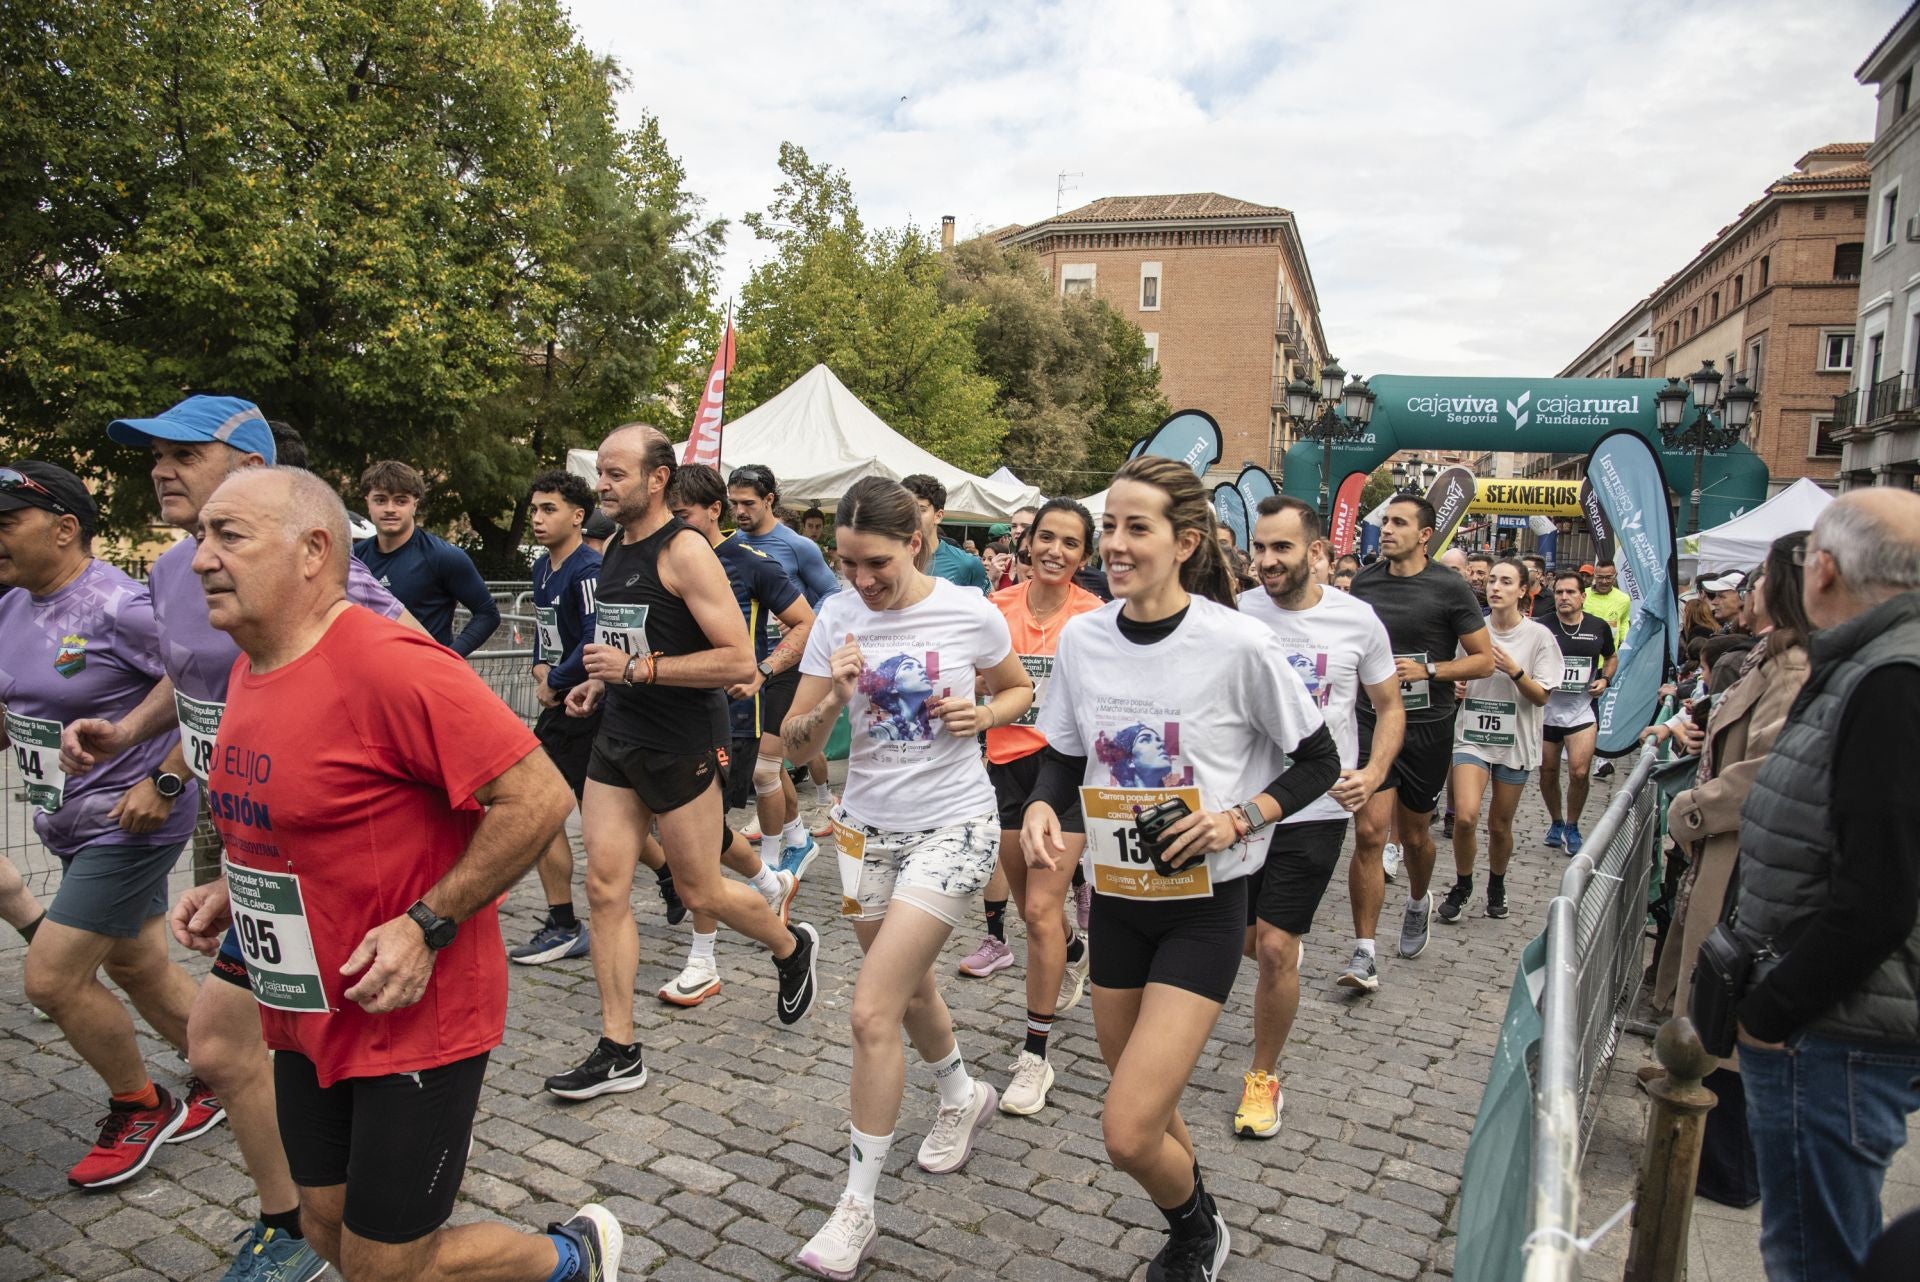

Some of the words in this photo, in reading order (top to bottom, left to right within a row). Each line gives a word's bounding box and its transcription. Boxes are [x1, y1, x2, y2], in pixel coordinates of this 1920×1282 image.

[1407, 393, 1499, 417] cajaviva
[1536, 394, 1640, 418] cajarural
[1446, 413, 1498, 425] Segovia
[1535, 413, 1610, 425] Fundación
[1486, 485, 1577, 508] SEXMEROS
[1499, 517, 1527, 526] META
[603, 631, 630, 655] 367
[1477, 714, 1501, 731] 175
[225, 745, 272, 786] ELIJO
[1098, 791, 1125, 801] Carrera
[1126, 793, 1157, 803] popular
[1157, 793, 1164, 801] 4
[1107, 811, 1134, 819] CONTRA
[233, 873, 258, 887] popular
[258, 878, 265, 887] 9
[250, 898, 276, 912] CÁNCER
[235, 910, 282, 965] 195
[263, 979, 307, 995] cajarural
